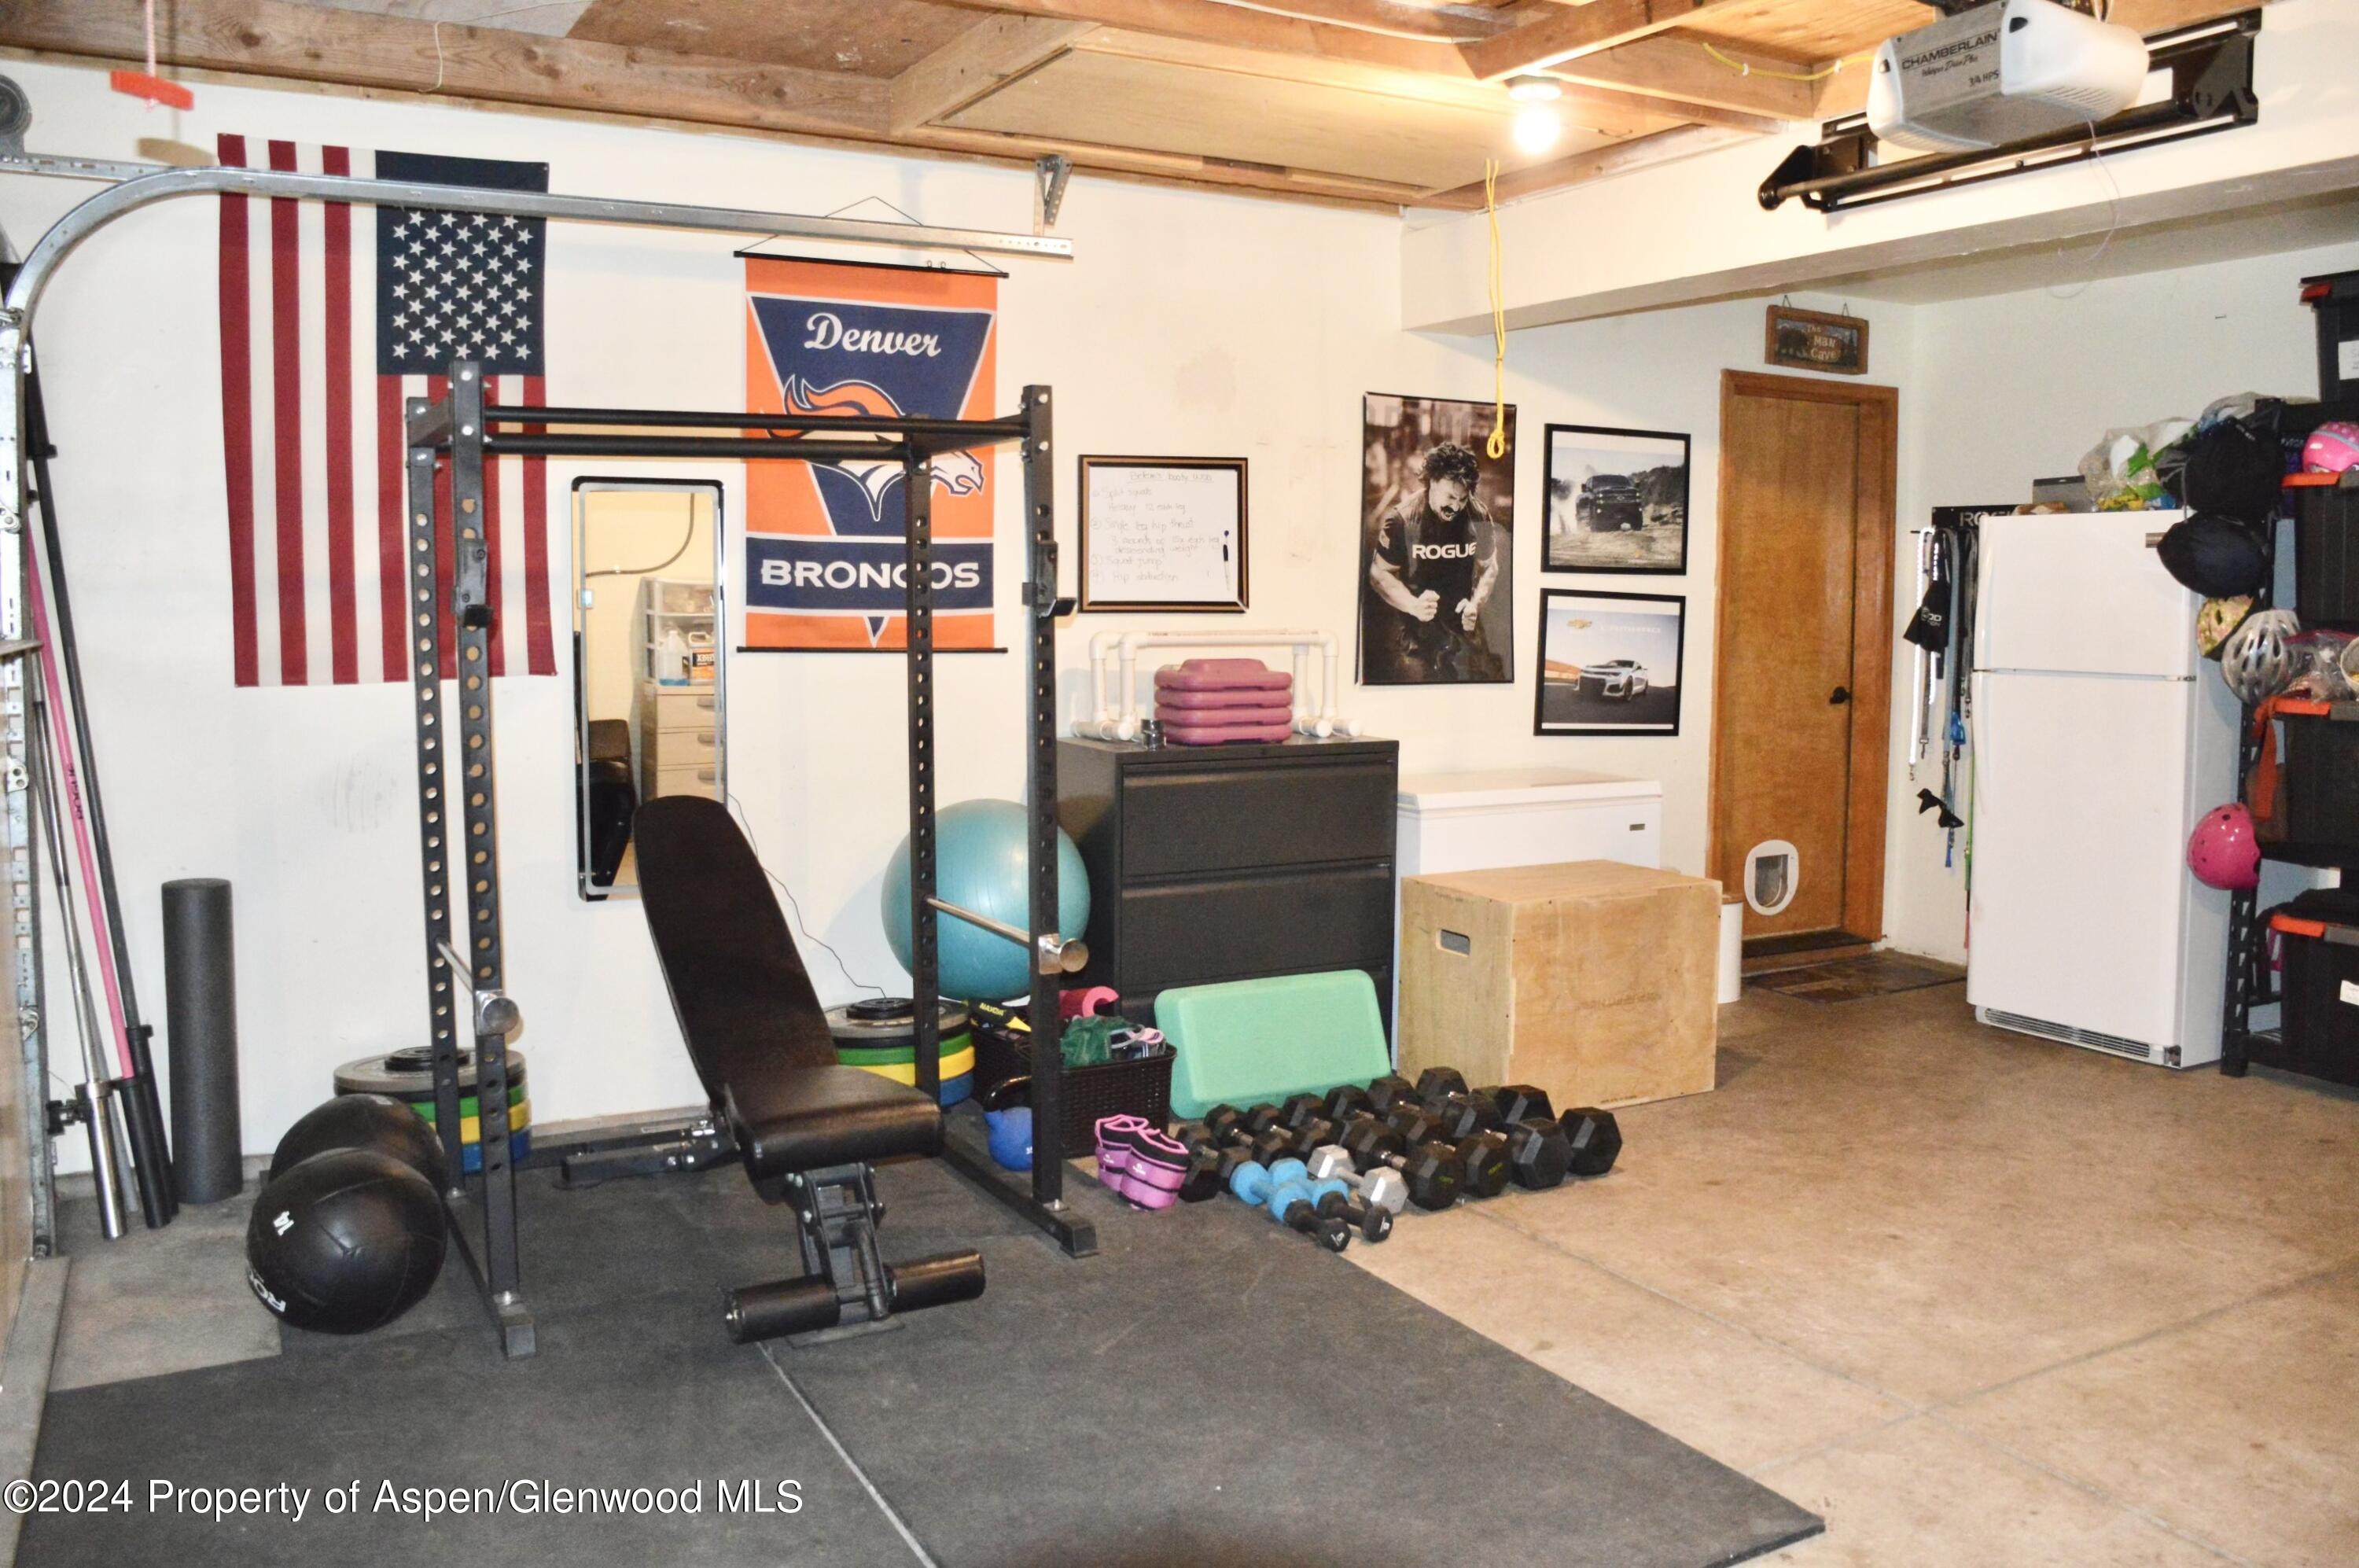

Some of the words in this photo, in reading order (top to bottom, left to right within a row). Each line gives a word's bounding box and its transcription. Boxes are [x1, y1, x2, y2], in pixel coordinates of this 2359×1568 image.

[1901, 31, 1998, 70] CHAMBERLAIN
[804, 312, 942, 357] Denver
[1411, 541, 1478, 560] ROGUE
[760, 558, 981, 590] BRONCOS
